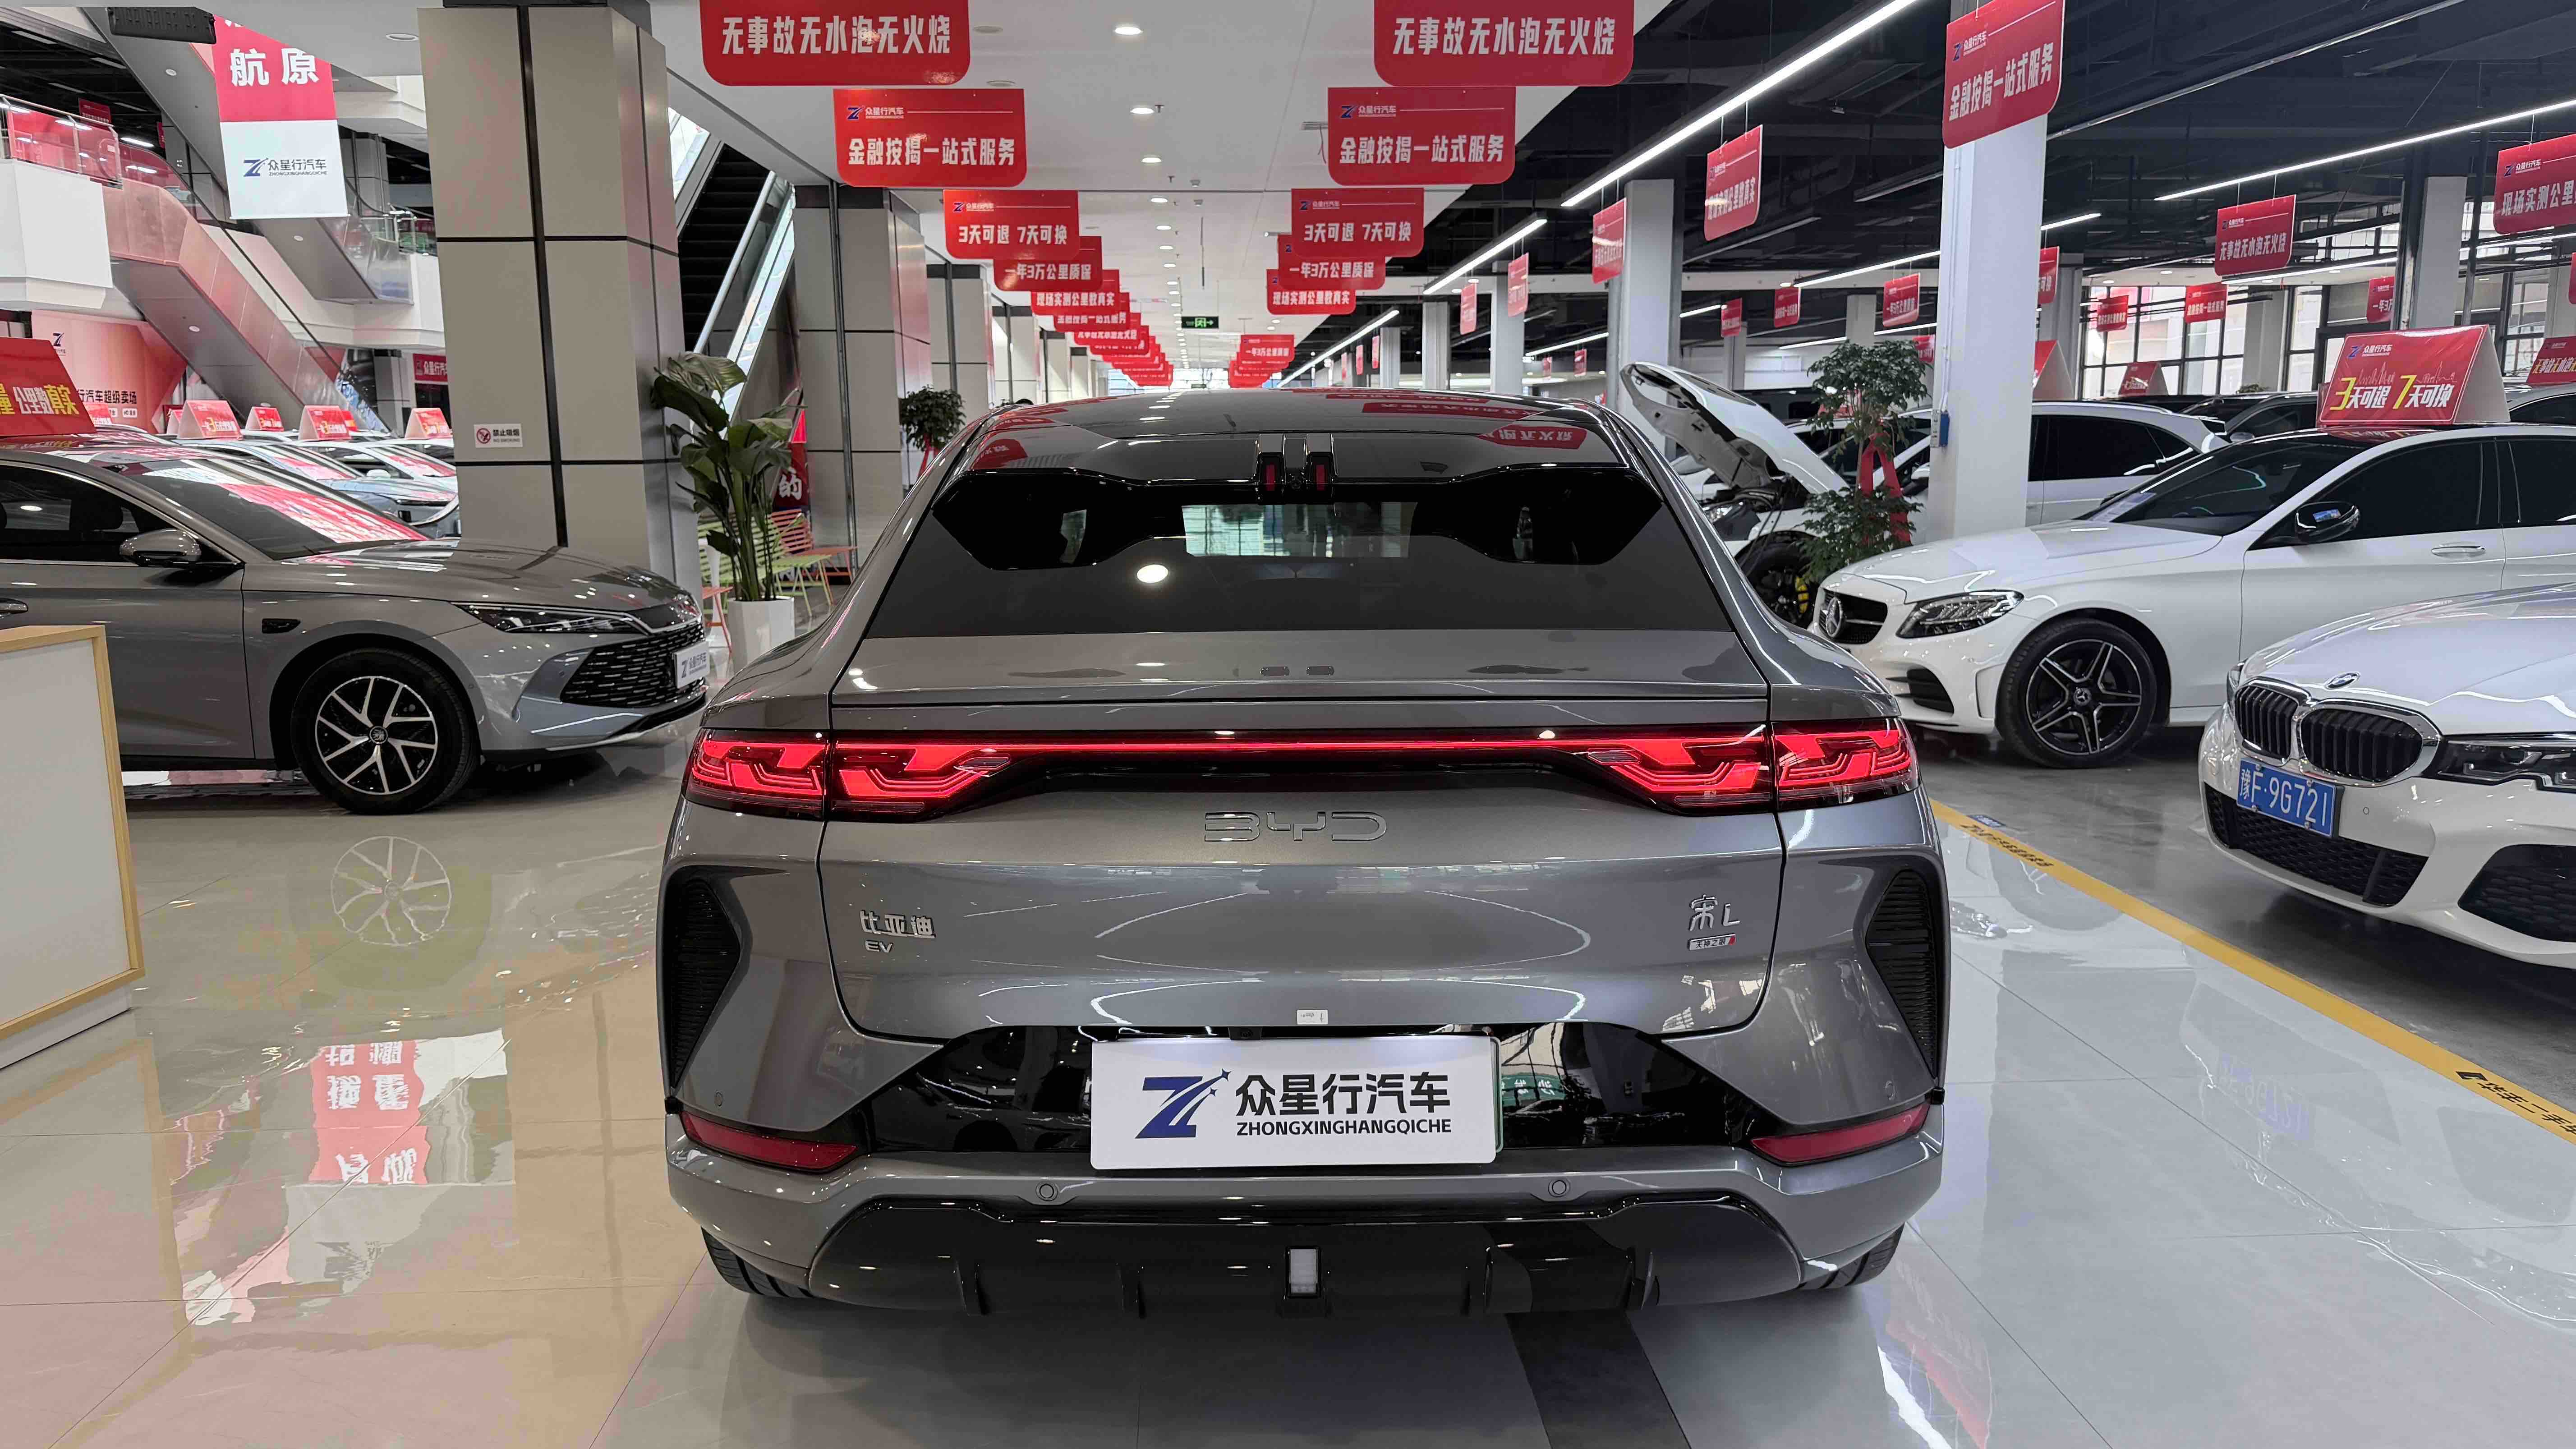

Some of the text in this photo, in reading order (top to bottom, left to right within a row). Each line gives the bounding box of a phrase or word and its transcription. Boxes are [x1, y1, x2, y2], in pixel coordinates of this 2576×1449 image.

[722, 15, 950, 55] 无事故无水泡无火烧
[1393, 17, 1616, 55] 无事故无水泡无火烧
[1949, 42, 2054, 122] 金融按揭一站式服务
[865, 107, 904, 115] 众星行汽车
[1358, 105, 1397, 115] 众星行汽车
[848, 138, 1015, 166] 金融按揭一站式服务
[1339, 134, 1504, 165] 金融按揭一站式服务
[267, 158, 327, 170] 众星行汽车
[958, 225, 1068, 245] 3天可退 7天可换
[1303, 221, 1412, 243] 3天可退 7天可换
[2219, 232, 2287, 261] 无事故无水泡无火烧
[1004, 263, 1091, 280] 一年3万公里质保
[1289, 262, 1375, 278] 一年3万公里质保
[2329, 375, 2455, 411] 3天可退 7天可换
[779, 466, 802, 500] 的
[1204, 811, 1388, 842] BYD
[860, 910, 936, 939] 比亚迪
[865, 940, 893, 953] EV
[1695, 937, 1726, 949] 天神之眼
[1236, 1071, 1451, 1116] 众星行汽车
[1237, 1118, 1452, 1136] ZHONGXINGHANGQICHE
